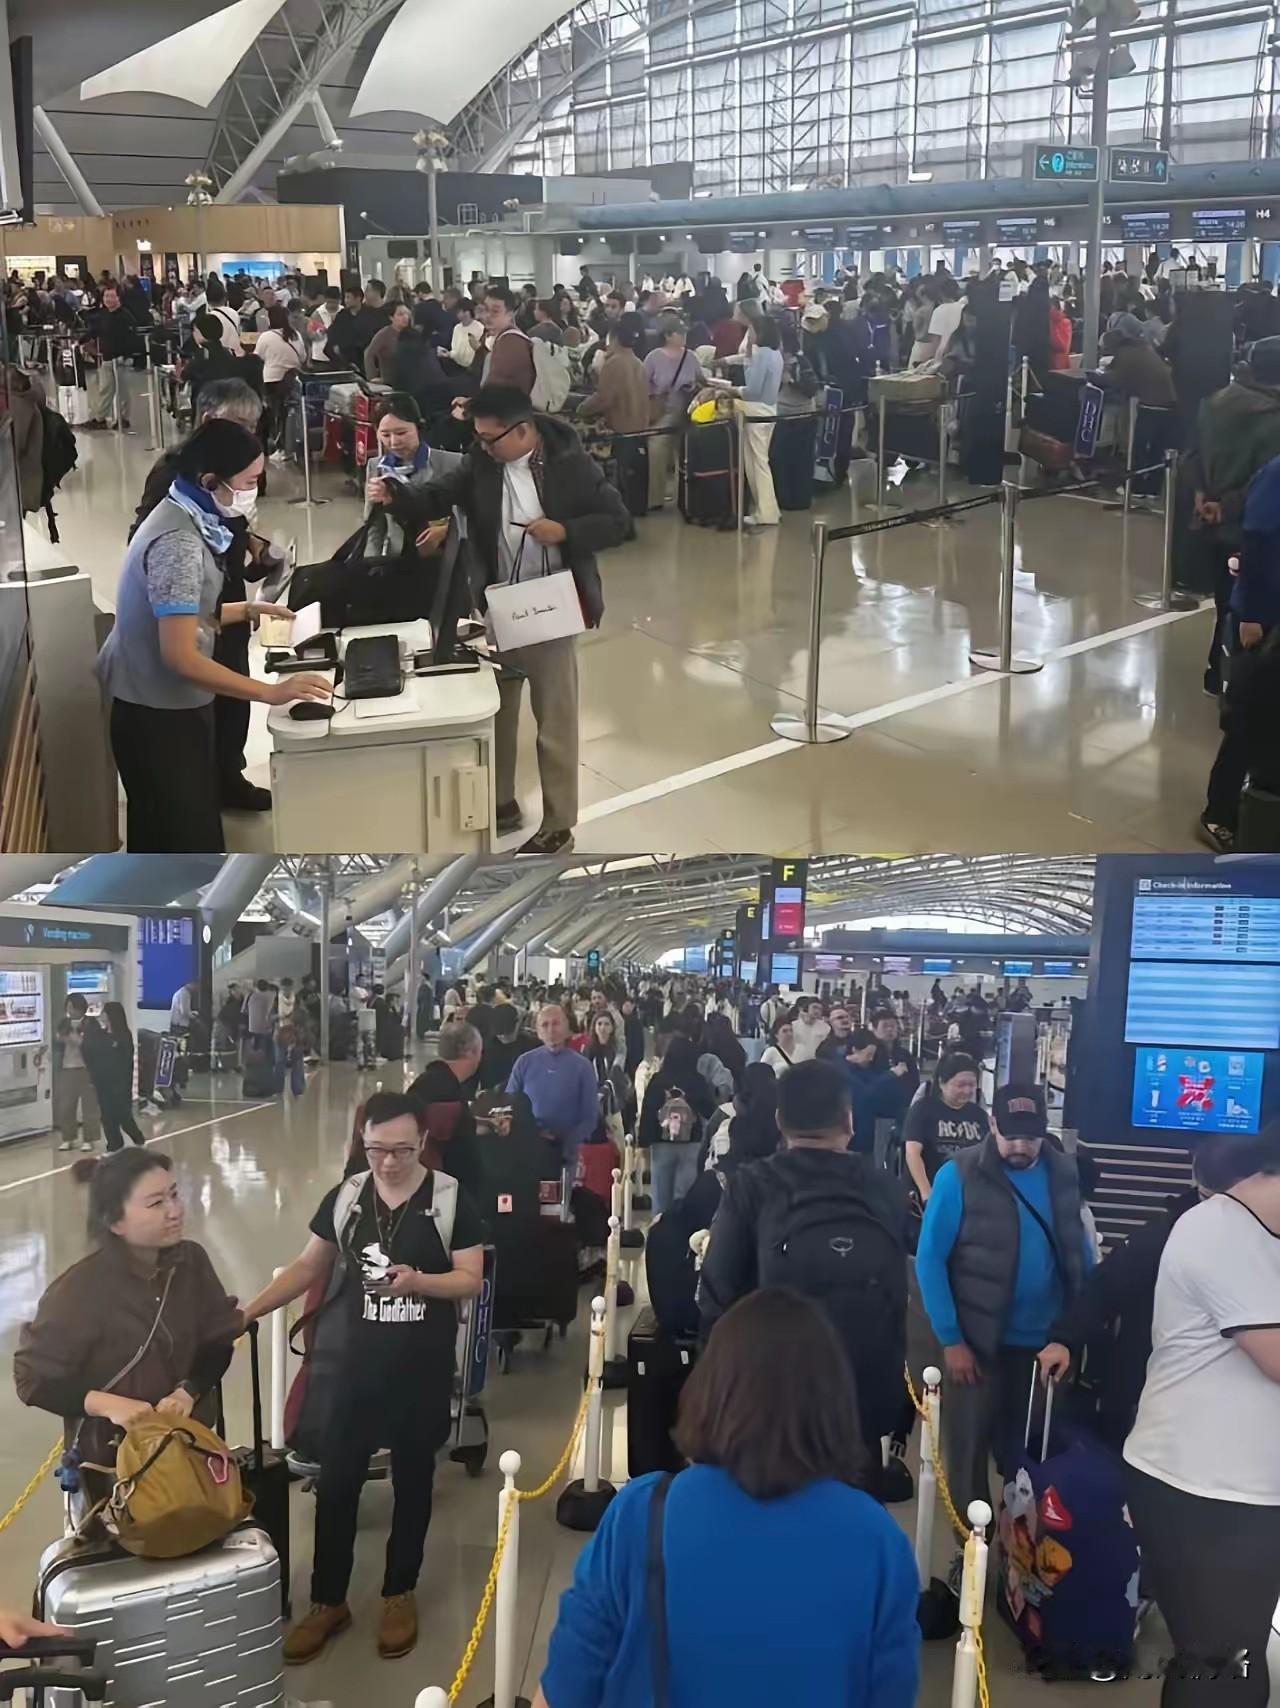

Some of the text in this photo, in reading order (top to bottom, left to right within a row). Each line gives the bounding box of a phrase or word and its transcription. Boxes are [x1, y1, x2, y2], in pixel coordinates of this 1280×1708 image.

[1256, 209, 1271, 218] H4
[783, 865, 796, 881] F
[747, 907, 756, 918] E
